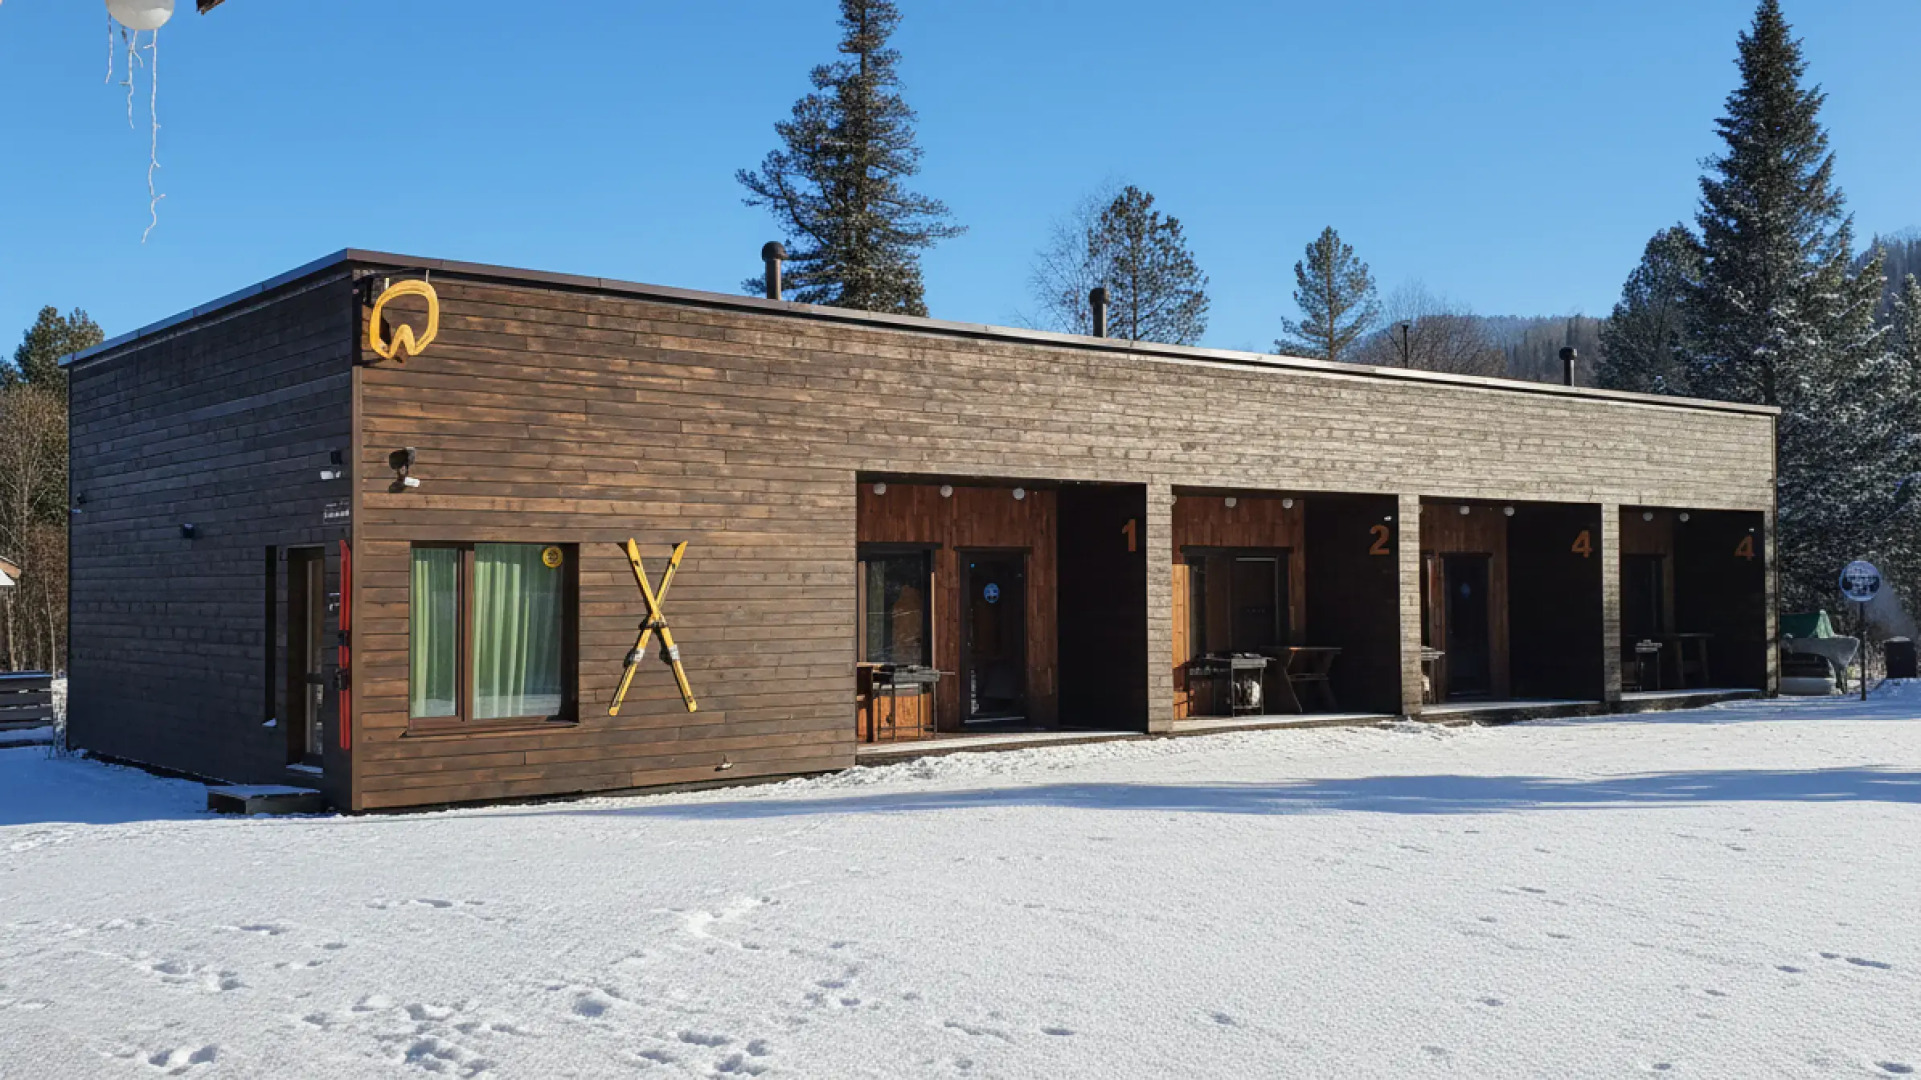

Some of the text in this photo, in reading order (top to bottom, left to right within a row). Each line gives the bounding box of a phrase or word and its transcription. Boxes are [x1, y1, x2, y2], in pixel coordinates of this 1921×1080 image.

[1121, 518, 1136, 552] 1
[1369, 524, 1390, 555] 2
[1571, 530, 1593, 558] 4
[1734, 536, 1755, 561] 4
